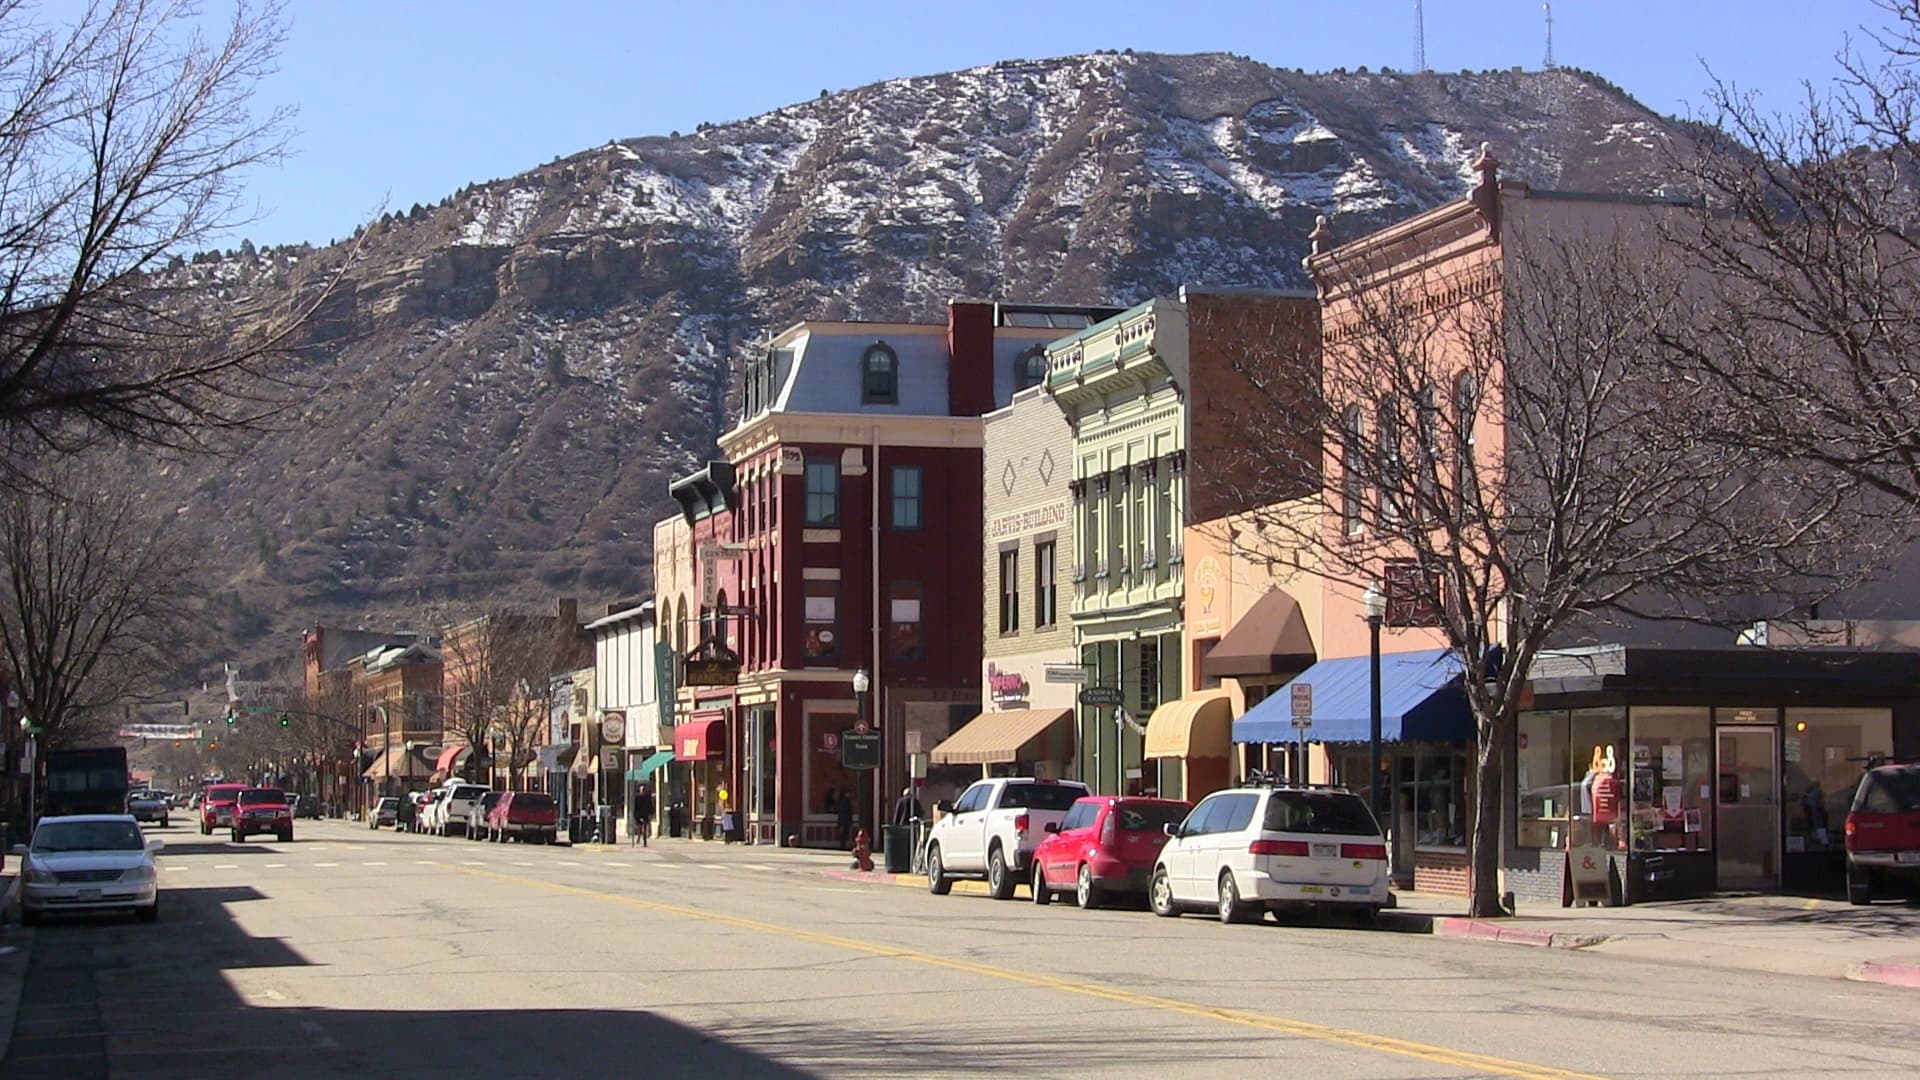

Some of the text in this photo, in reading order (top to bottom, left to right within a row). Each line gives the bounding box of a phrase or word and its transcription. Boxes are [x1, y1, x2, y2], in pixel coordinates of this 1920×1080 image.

[1023, 502, 1066, 530] BUILDING
[706, 560, 714, 603] HOTEL
[688, 673, 736, 685] RANCHO
